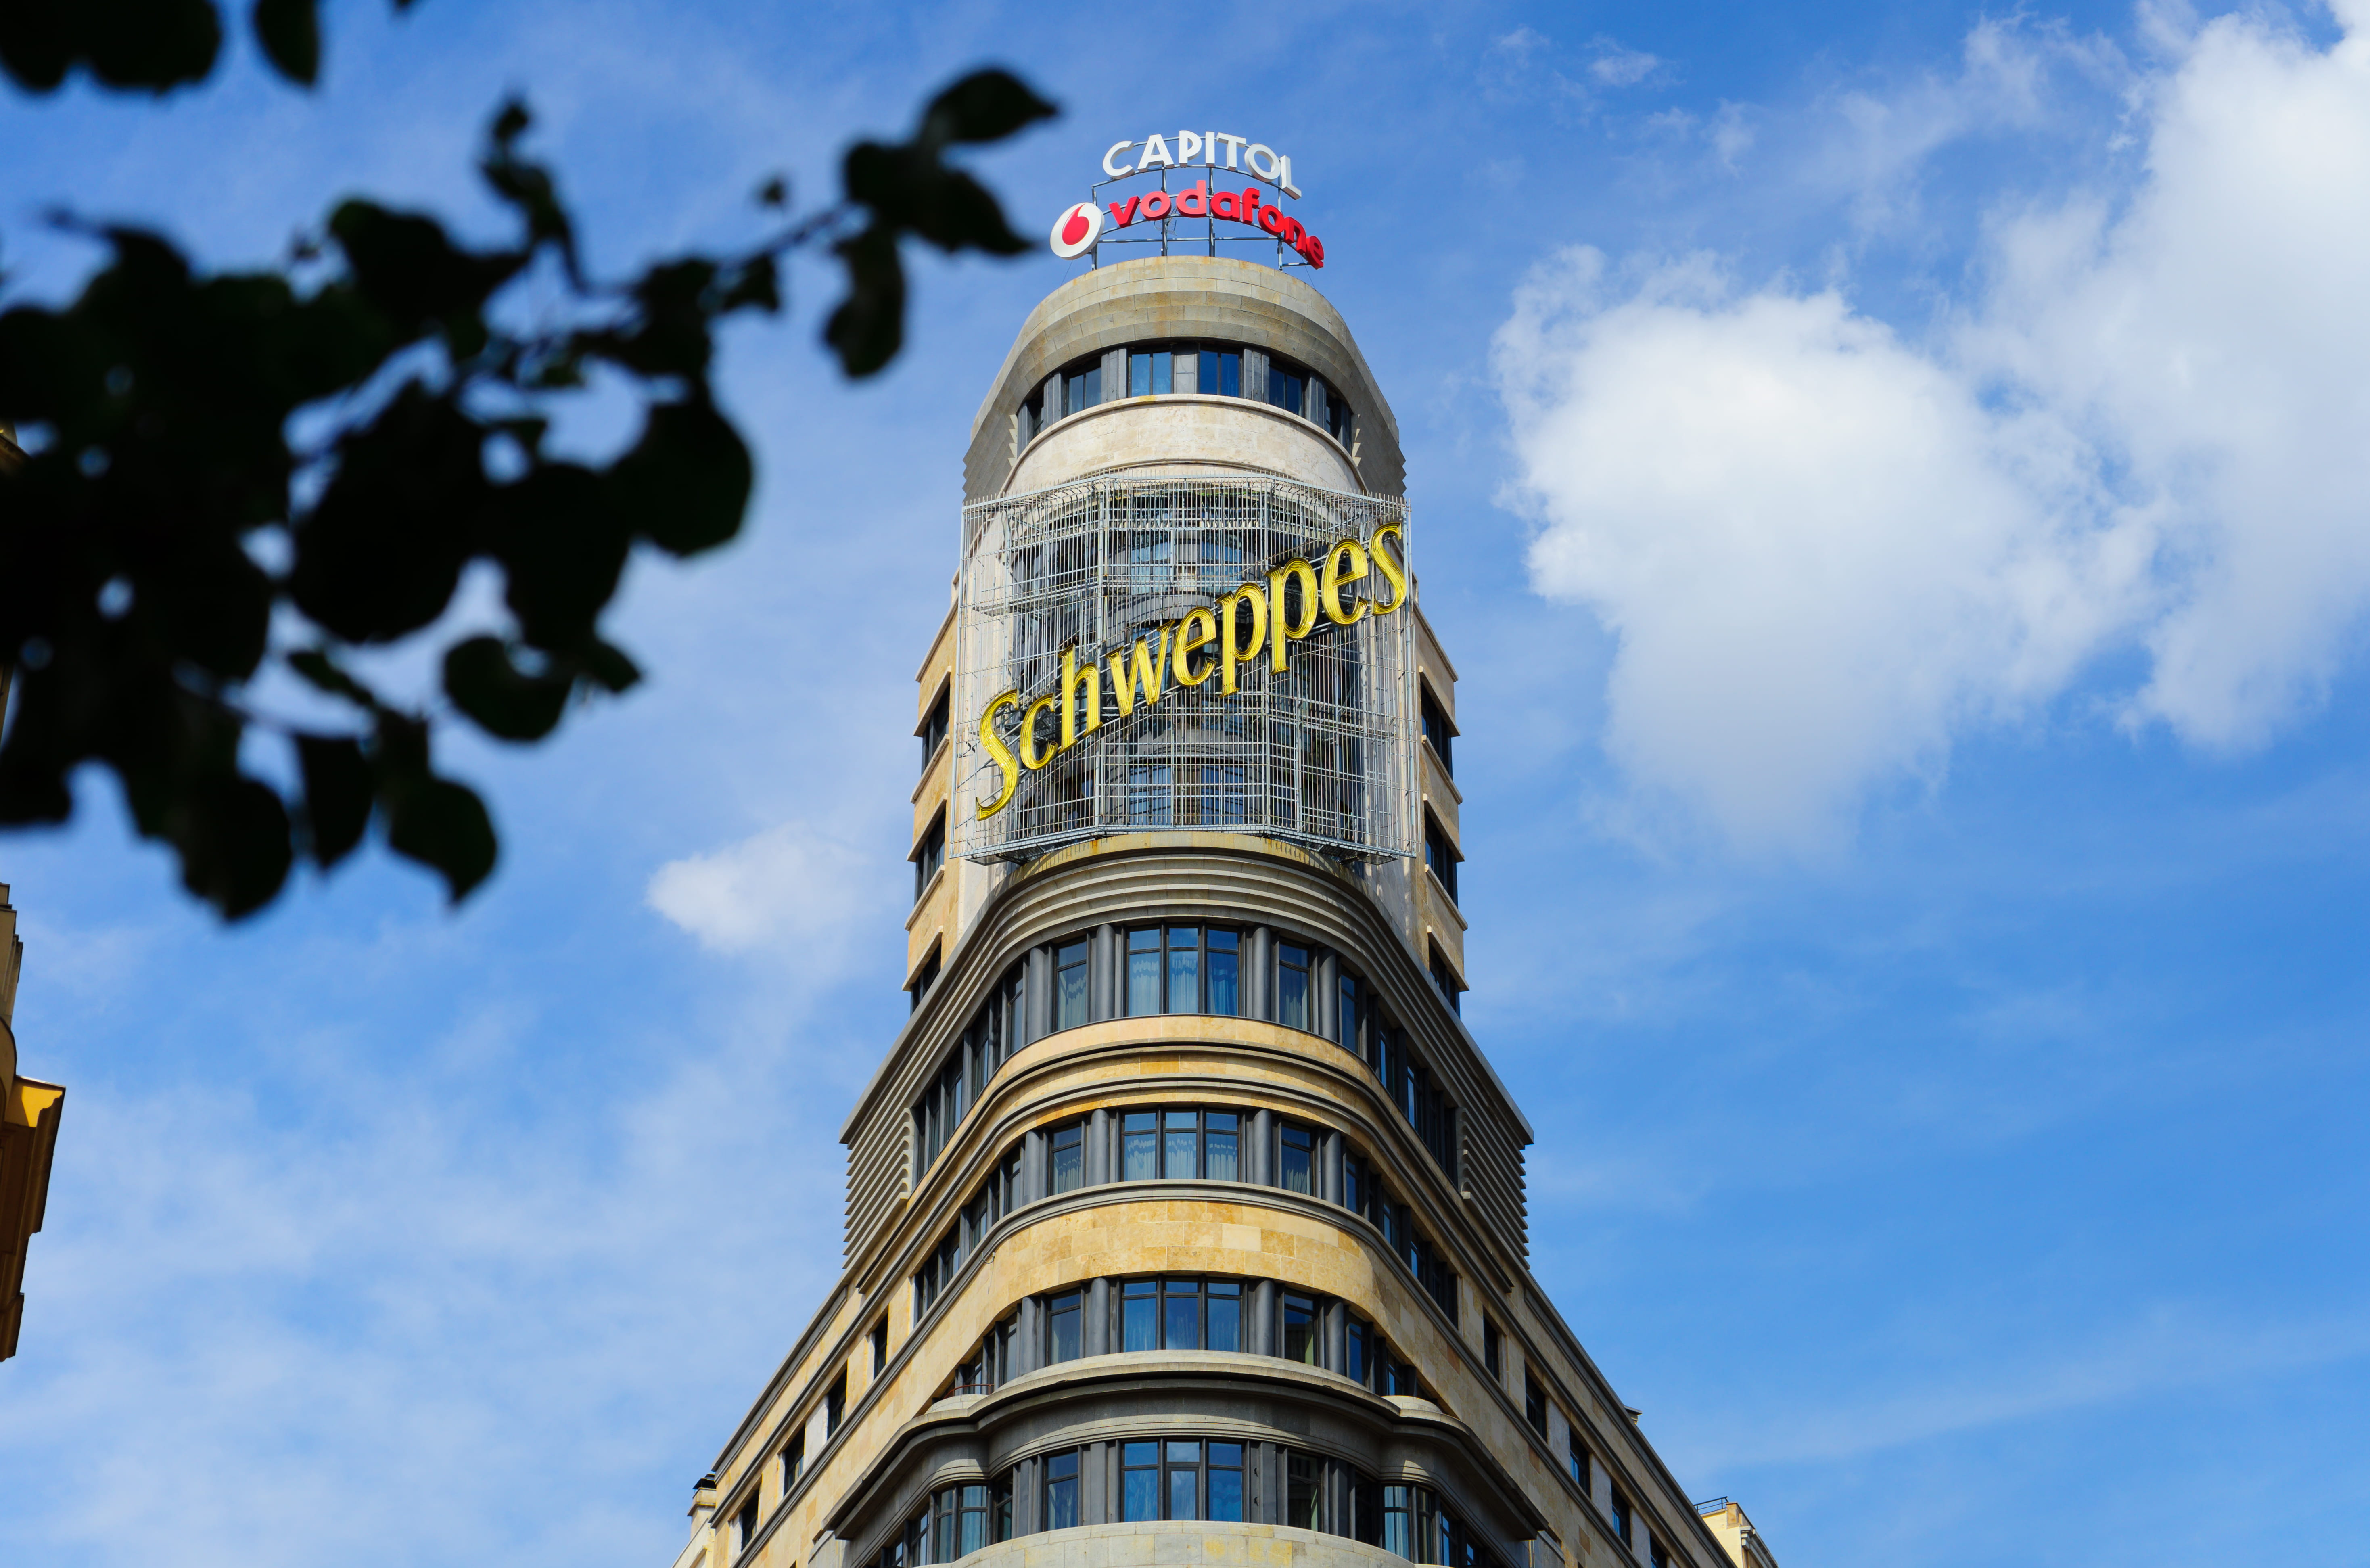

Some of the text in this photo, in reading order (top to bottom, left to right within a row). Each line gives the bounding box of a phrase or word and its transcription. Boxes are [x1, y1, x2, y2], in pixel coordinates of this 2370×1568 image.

[1103, 130, 1301, 200] CAPITOL
[1109, 180, 1324, 270] vodafone
[976, 522, 1407, 821] Schweppes
